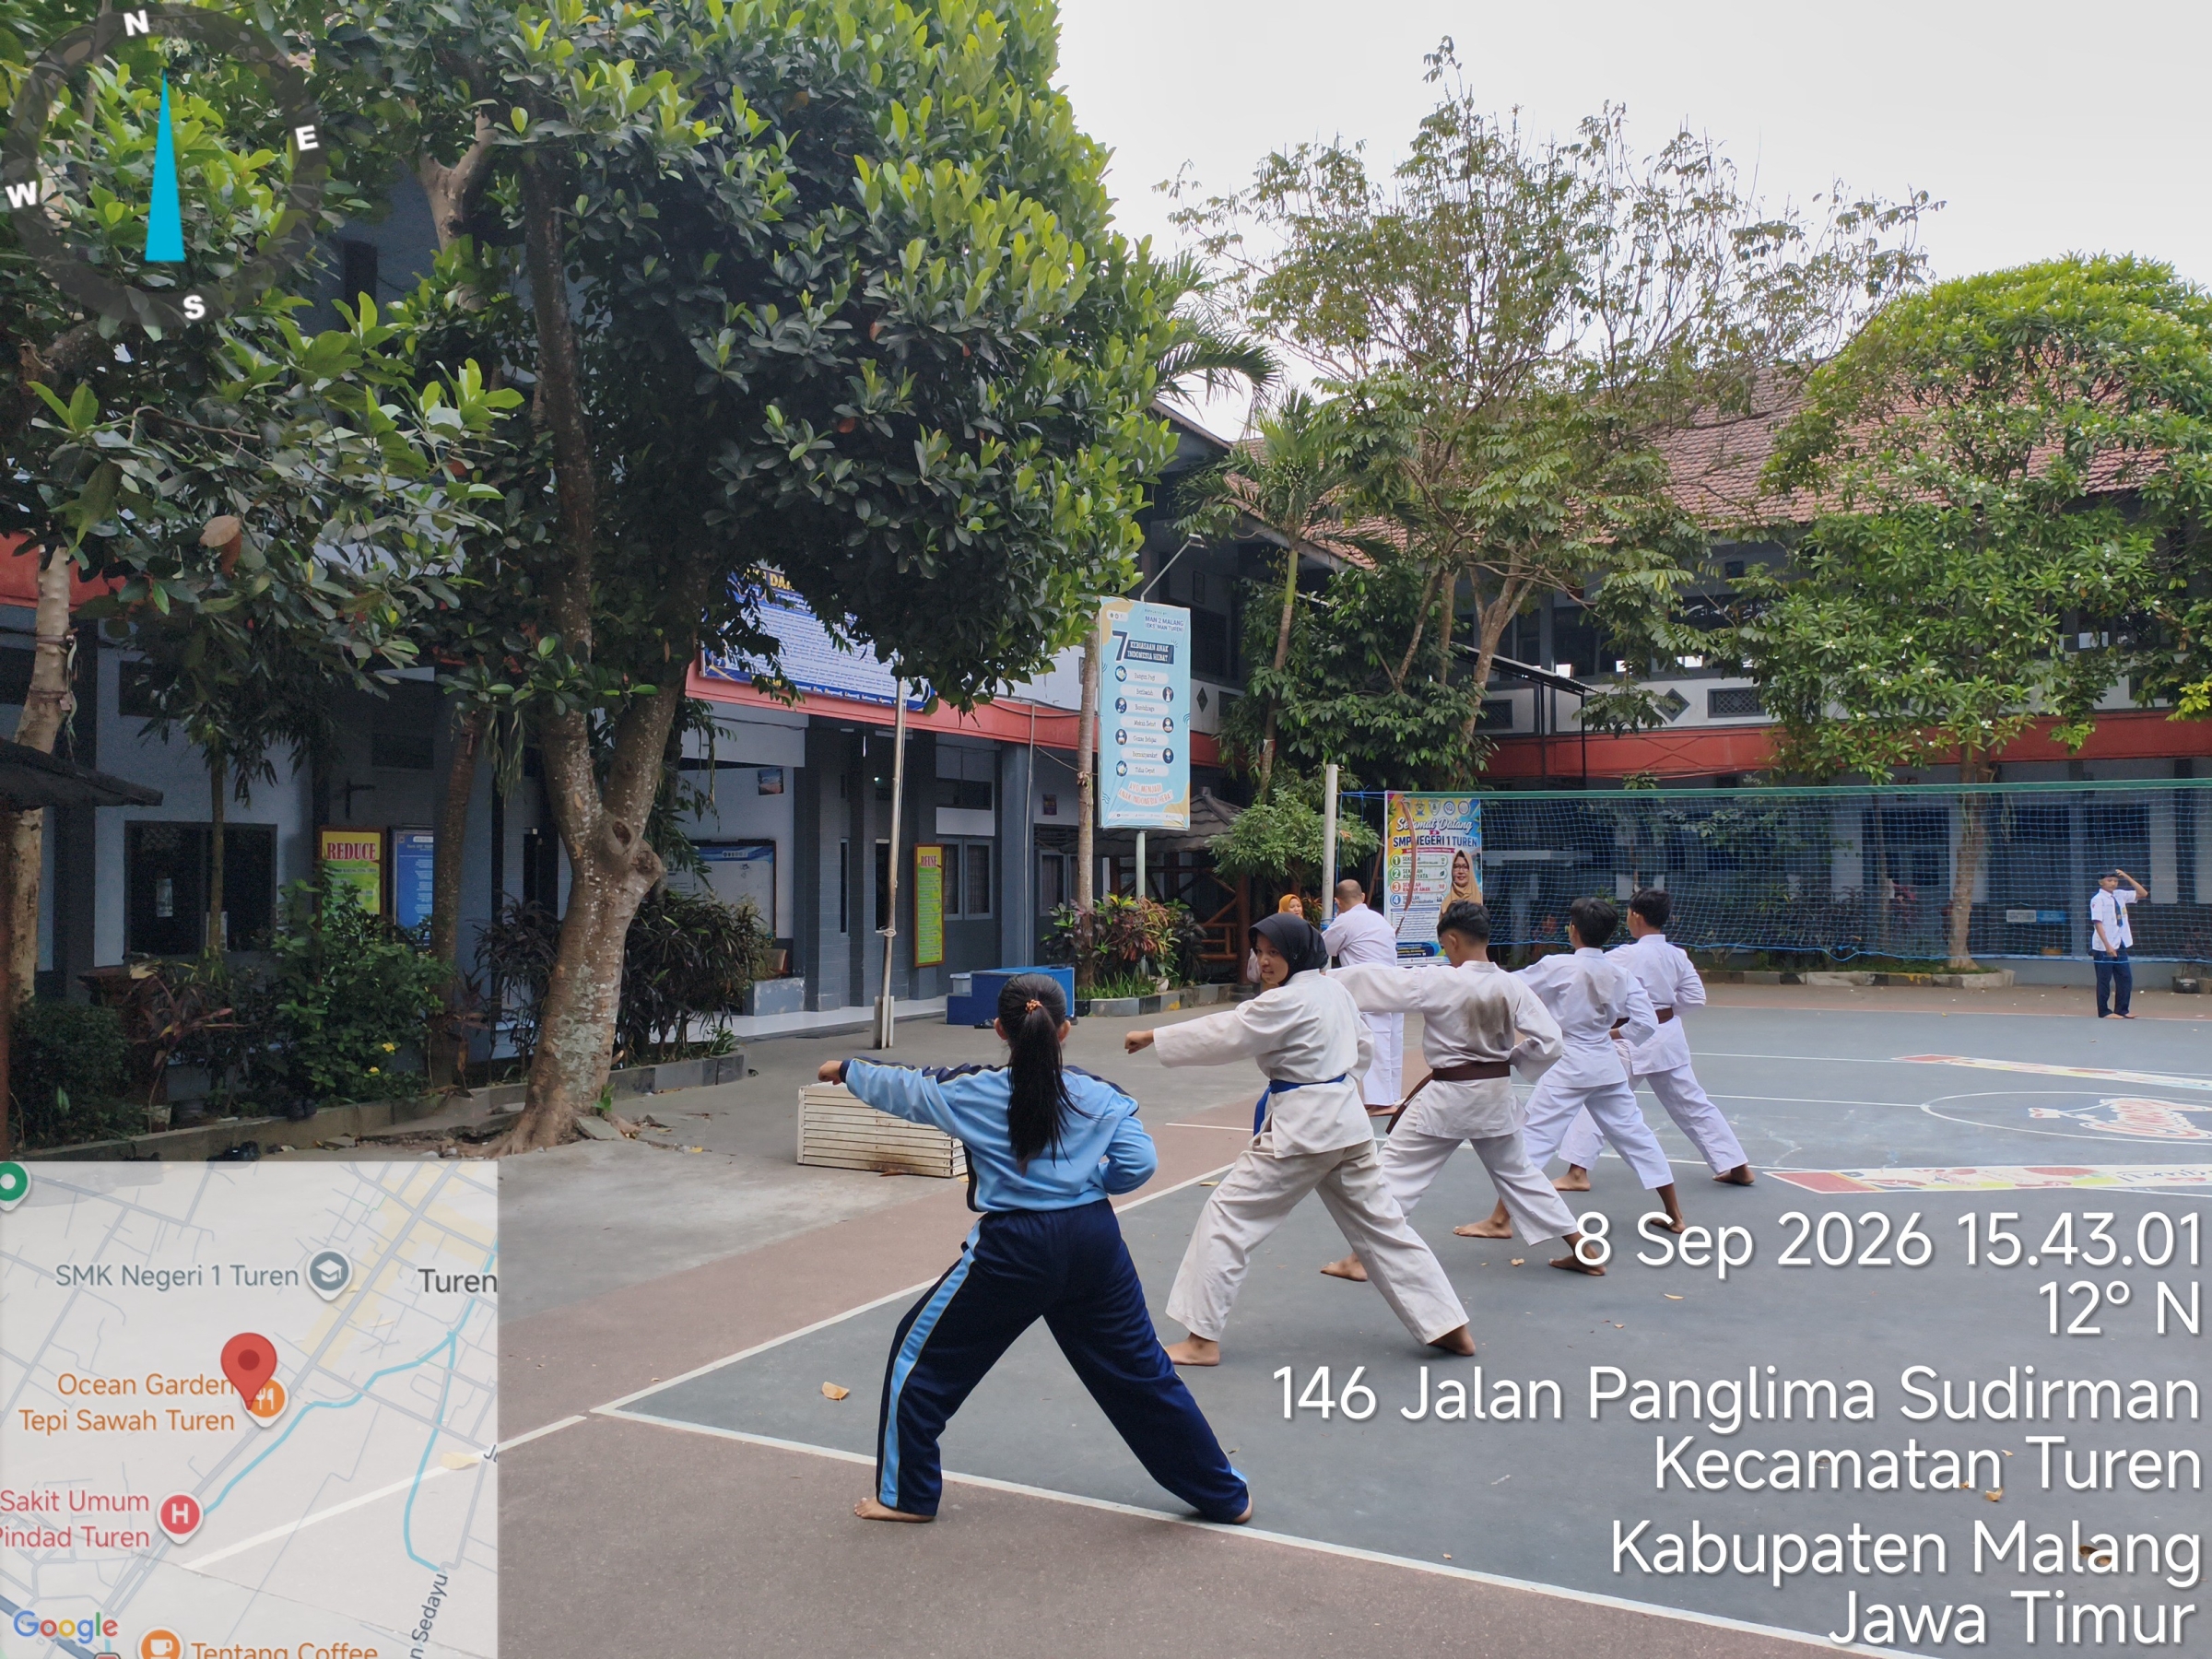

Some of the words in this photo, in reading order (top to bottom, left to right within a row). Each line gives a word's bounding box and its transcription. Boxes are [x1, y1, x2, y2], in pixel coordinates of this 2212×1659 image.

[1162, 618, 1184, 627] MALANG
[1112, 630, 1128, 662] 7
[1438, 817, 1473, 835] Datang
[1393, 836, 1412, 847] SMP
[1446, 835, 1451, 845] 1
[1453, 836, 1477, 847] TUREN
[326, 842, 376, 861] REDUCE
[921, 855, 937, 867] REUSE
[1394, 868, 1399, 877] 2
[1394, 882, 1399, 891] 3
